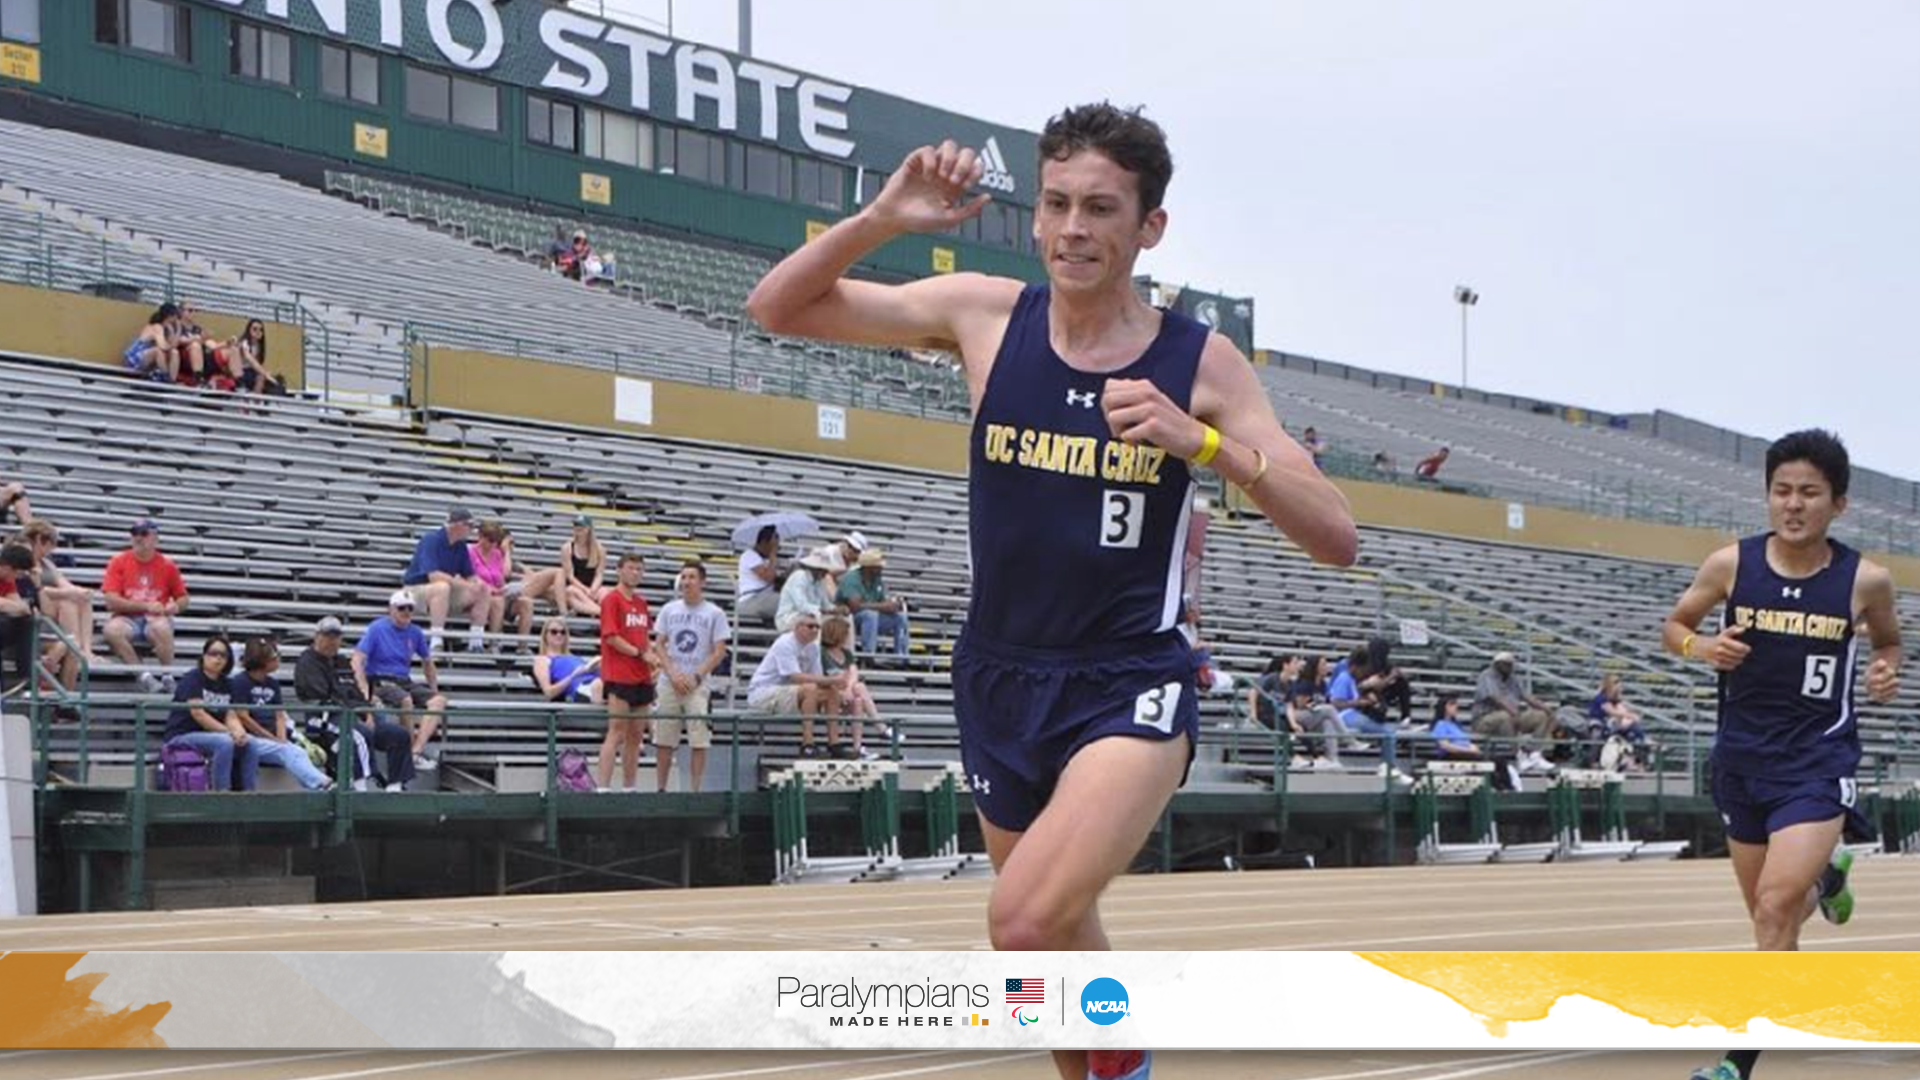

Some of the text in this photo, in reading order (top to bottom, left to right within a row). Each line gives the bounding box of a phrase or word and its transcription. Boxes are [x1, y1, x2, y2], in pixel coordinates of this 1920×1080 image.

[539, 8, 856, 158] STATE
[985, 423, 1167, 484] UC SANTA CRUZ
[1106, 494, 1131, 544] 3
[1735, 606, 1848, 640] UC SANTA CRUZ
[1809, 658, 1831, 695] 5
[1141, 687, 1167, 723] 3
